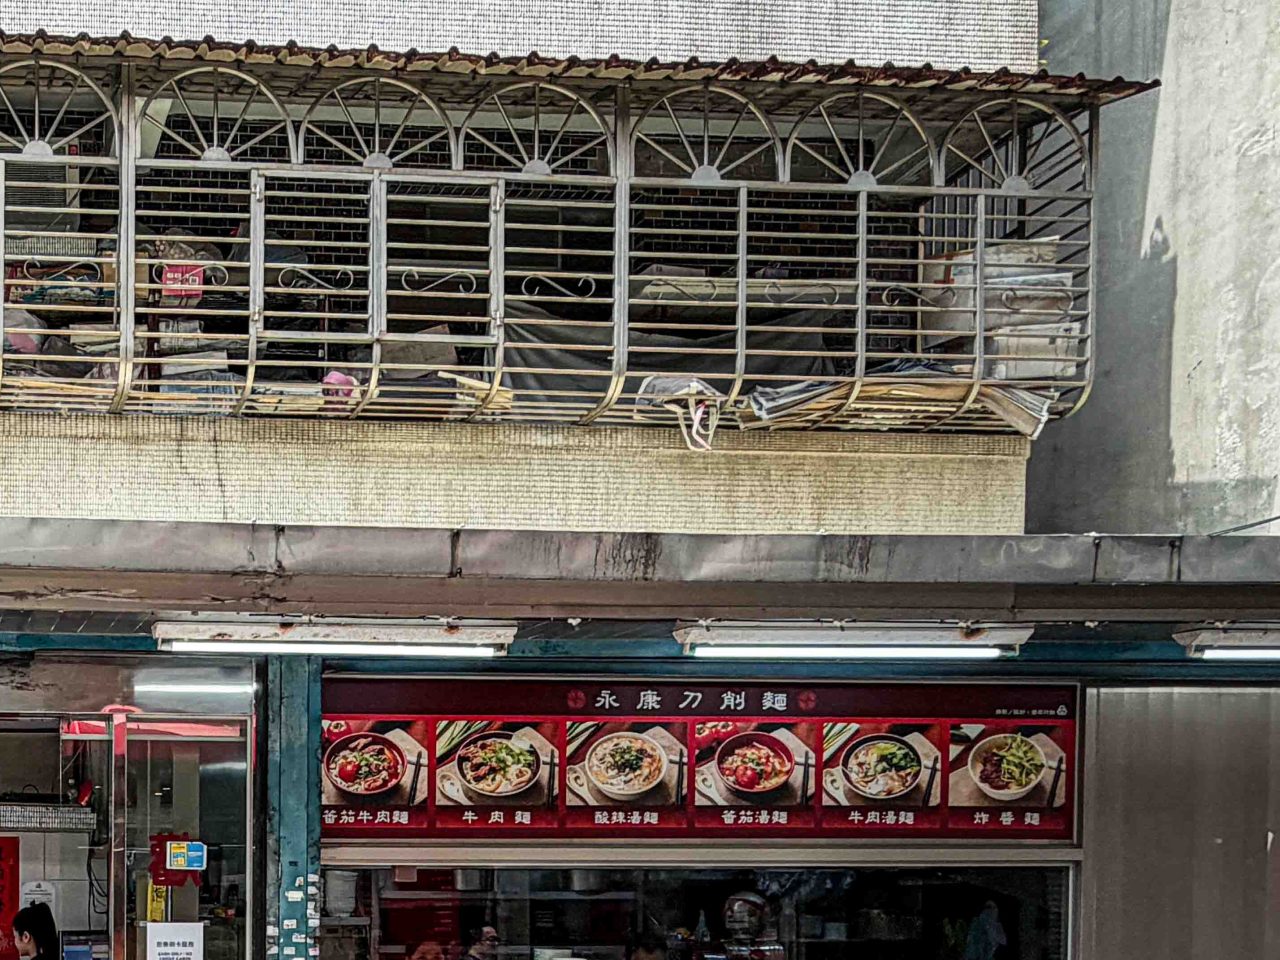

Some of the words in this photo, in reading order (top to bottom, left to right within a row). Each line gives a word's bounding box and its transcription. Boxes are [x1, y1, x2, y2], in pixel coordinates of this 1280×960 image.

[594, 689, 788, 711] 永康刀削麵
[462, 810, 531, 824] 牛肉麵
[594, 811, 659, 824] 酸辣湯麵
[848, 810, 915, 825] 牛肉湯麵
[973, 811, 1041, 826] 炸醬麵
